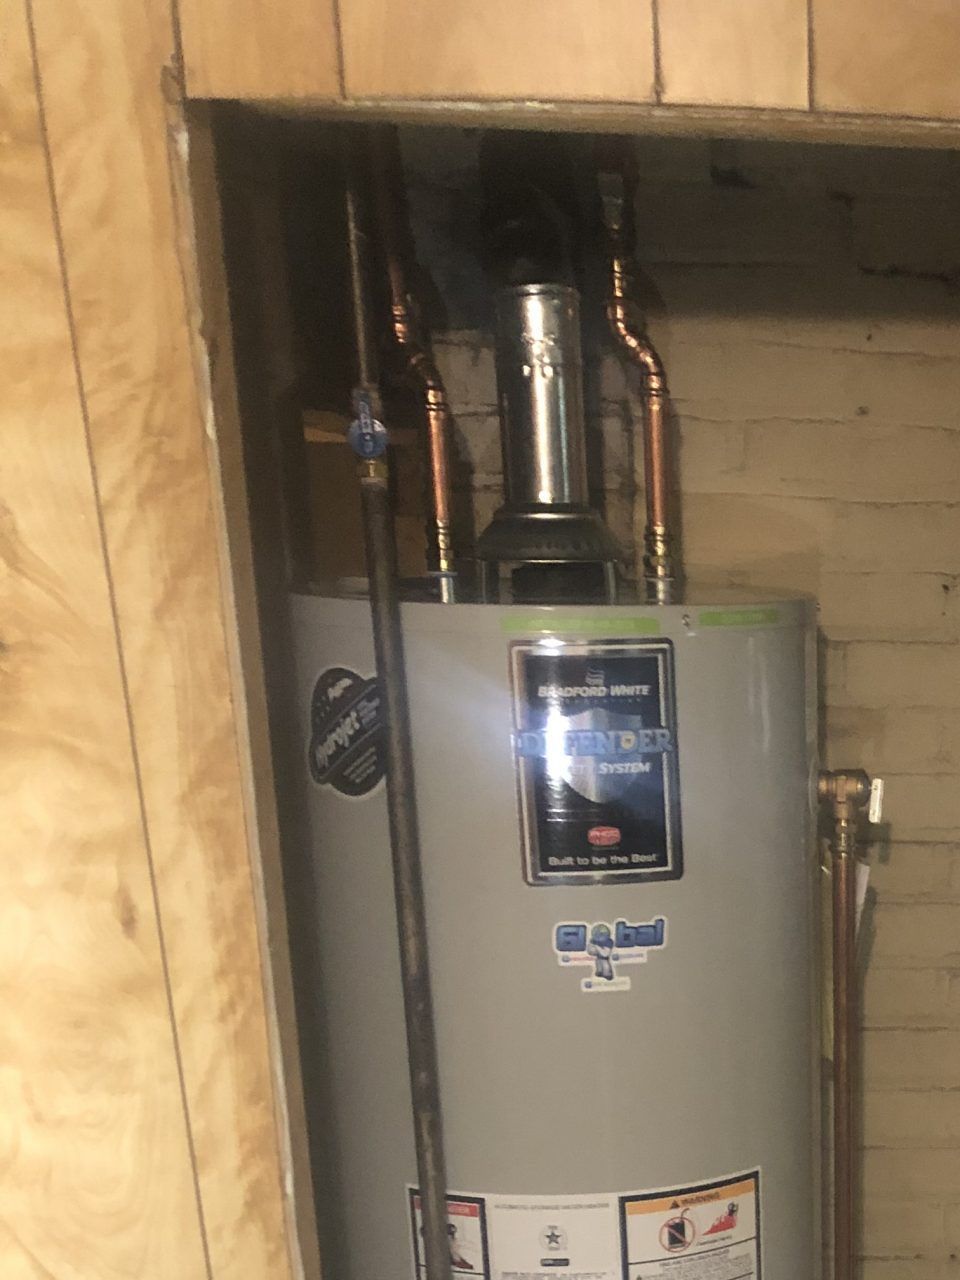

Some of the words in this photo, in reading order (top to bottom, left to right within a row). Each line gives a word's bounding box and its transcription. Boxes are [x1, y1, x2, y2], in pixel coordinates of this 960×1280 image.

[538, 685, 606, 697] BRADFORD
[609, 684, 651, 696] WHITE
[598, 761, 651, 775] SYSTEM
[548, 856, 575, 866] Built
[576, 856, 590, 865] to
[592, 856, 607, 865] be
[610, 854, 629, 864] the
[631, 853, 657, 863] Best
